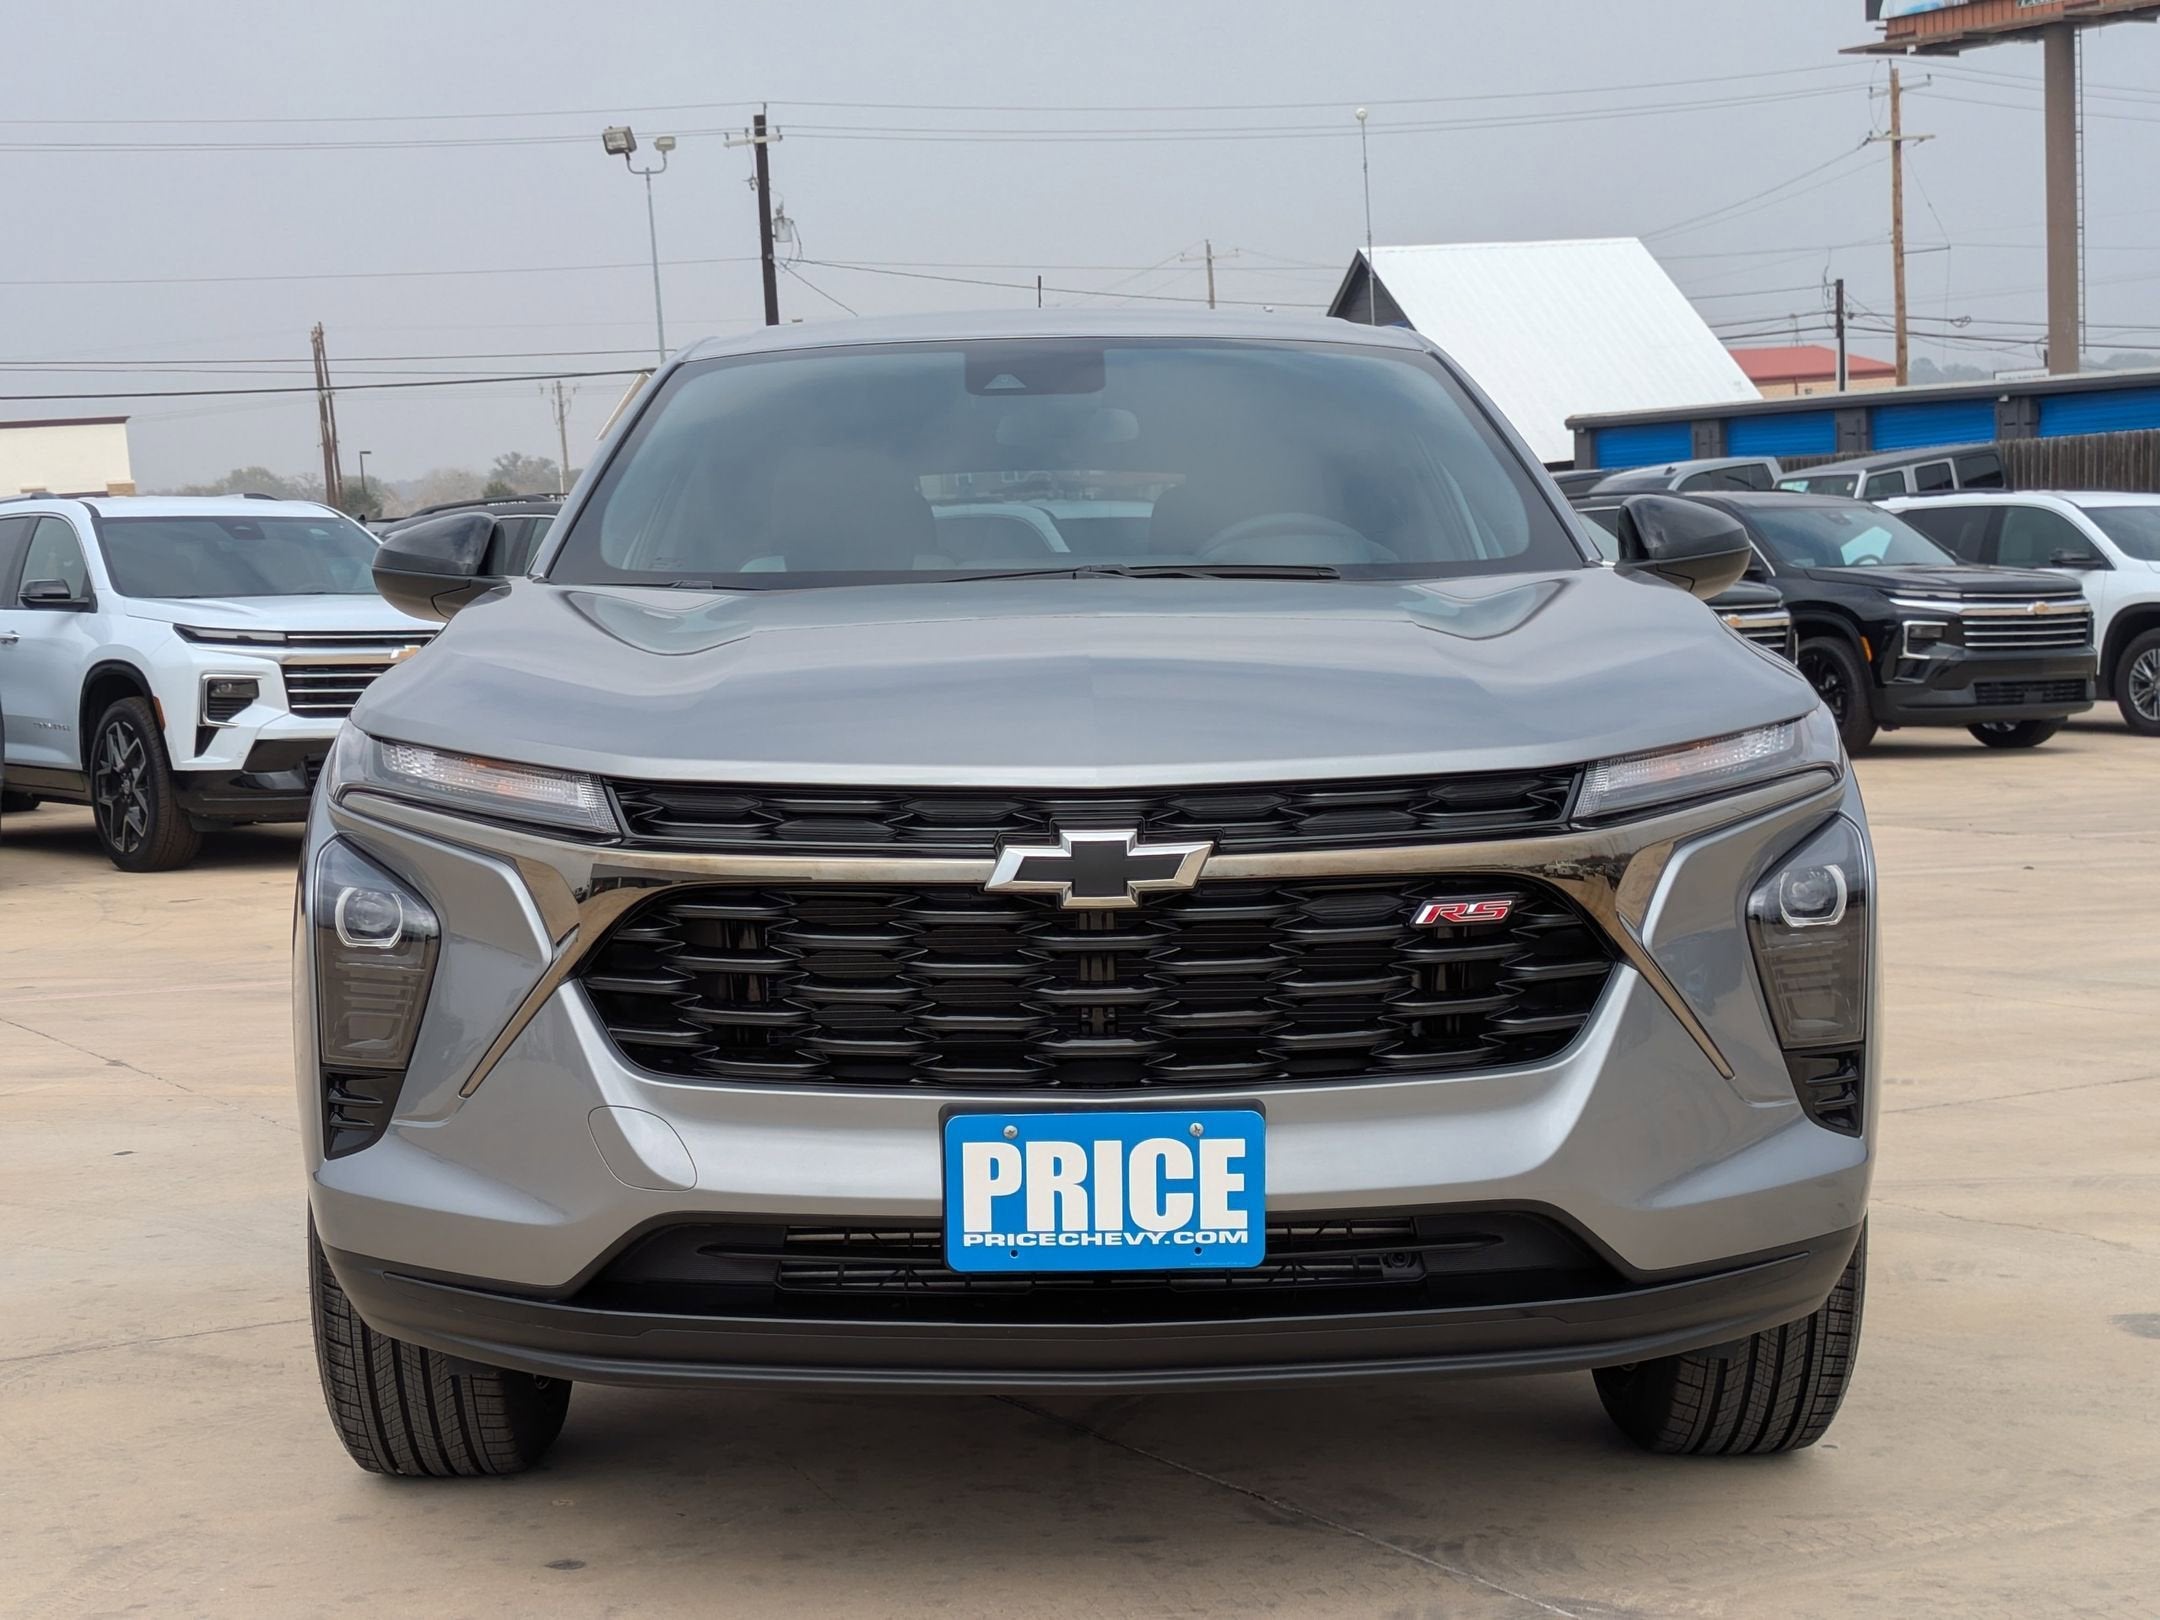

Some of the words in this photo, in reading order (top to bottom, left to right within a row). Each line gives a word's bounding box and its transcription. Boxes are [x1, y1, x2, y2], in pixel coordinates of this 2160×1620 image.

[1415, 900, 1513, 925] RS
[962, 1137, 1248, 1233] PRICE
[963, 1230, 1248, 1247] PRICECHEVY.COM
